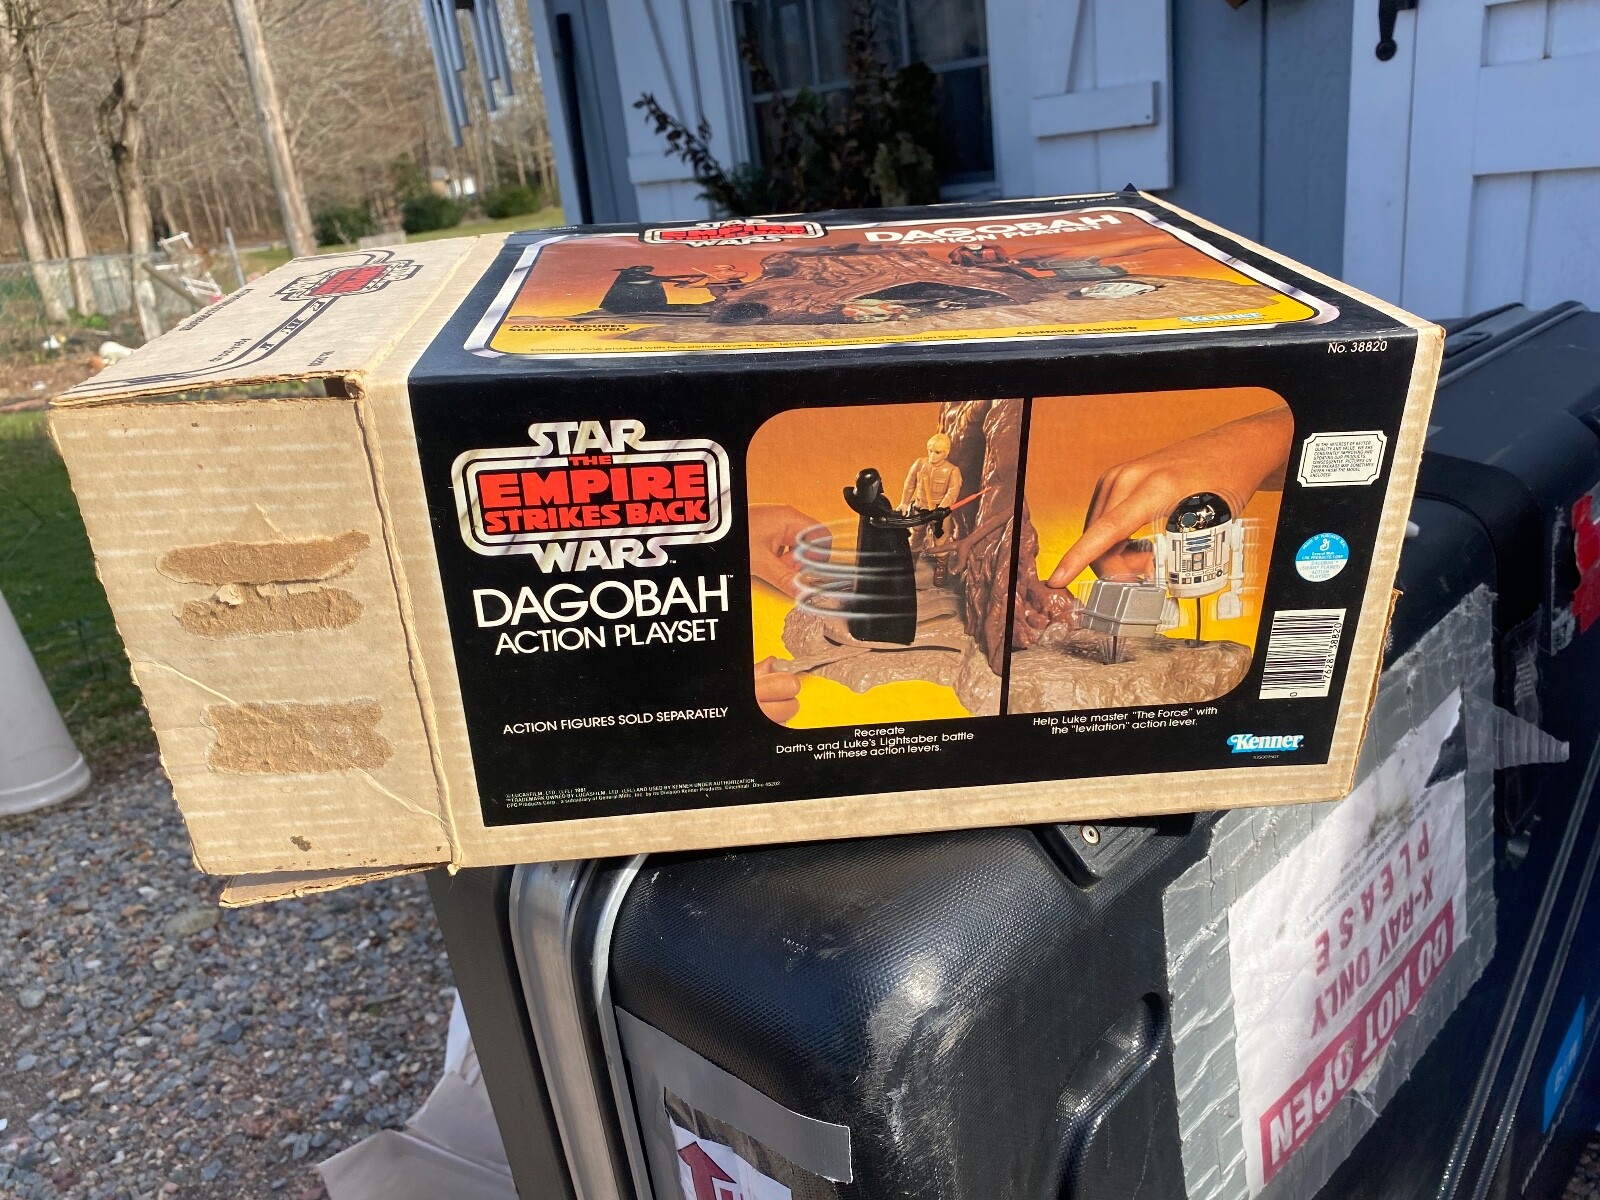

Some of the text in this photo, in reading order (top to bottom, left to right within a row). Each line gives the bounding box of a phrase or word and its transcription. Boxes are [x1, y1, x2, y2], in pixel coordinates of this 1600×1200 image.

[864, 214, 1122, 242] DAGOBAH
[898, 224, 1102, 245] ACTION PLAYSET
[1328, 340, 1388, 354] No. 38820
[528, 420, 645, 455] STAR
[569, 455, 613, 465] THE
[479, 464, 705, 508] EMPIRE
[484, 500, 706, 532] STRIKES BACK
[531, 538, 668, 573] WARS
[472, 575, 729, 628] DAGOBAH
[495, 619, 718, 655] ACTION PLAYSET
[1329, 623, 1342, 649] 38820
[503, 707, 729, 735] ACTION FIGURES SOLD SEPARATELY
[1033, 707, 1218, 726] Help Luke master "The Force" with
[1051, 718, 1198, 735] the "levitation" action lever.
[776, 732, 974, 754] Darth's and Luke's Lightsaber battle
[854, 726, 905, 738] Recreate
[1228, 734, 1304, 752] Kenner
[814, 743, 942, 760] with these action levers.
[1315, 819, 1430, 976] PLEASE
[1378, 866, 1434, 967] X-RAY
[1311, 946, 1371, 1040] ONLY
[1269, 918, 1448, 1166] DO NOT OPEN
